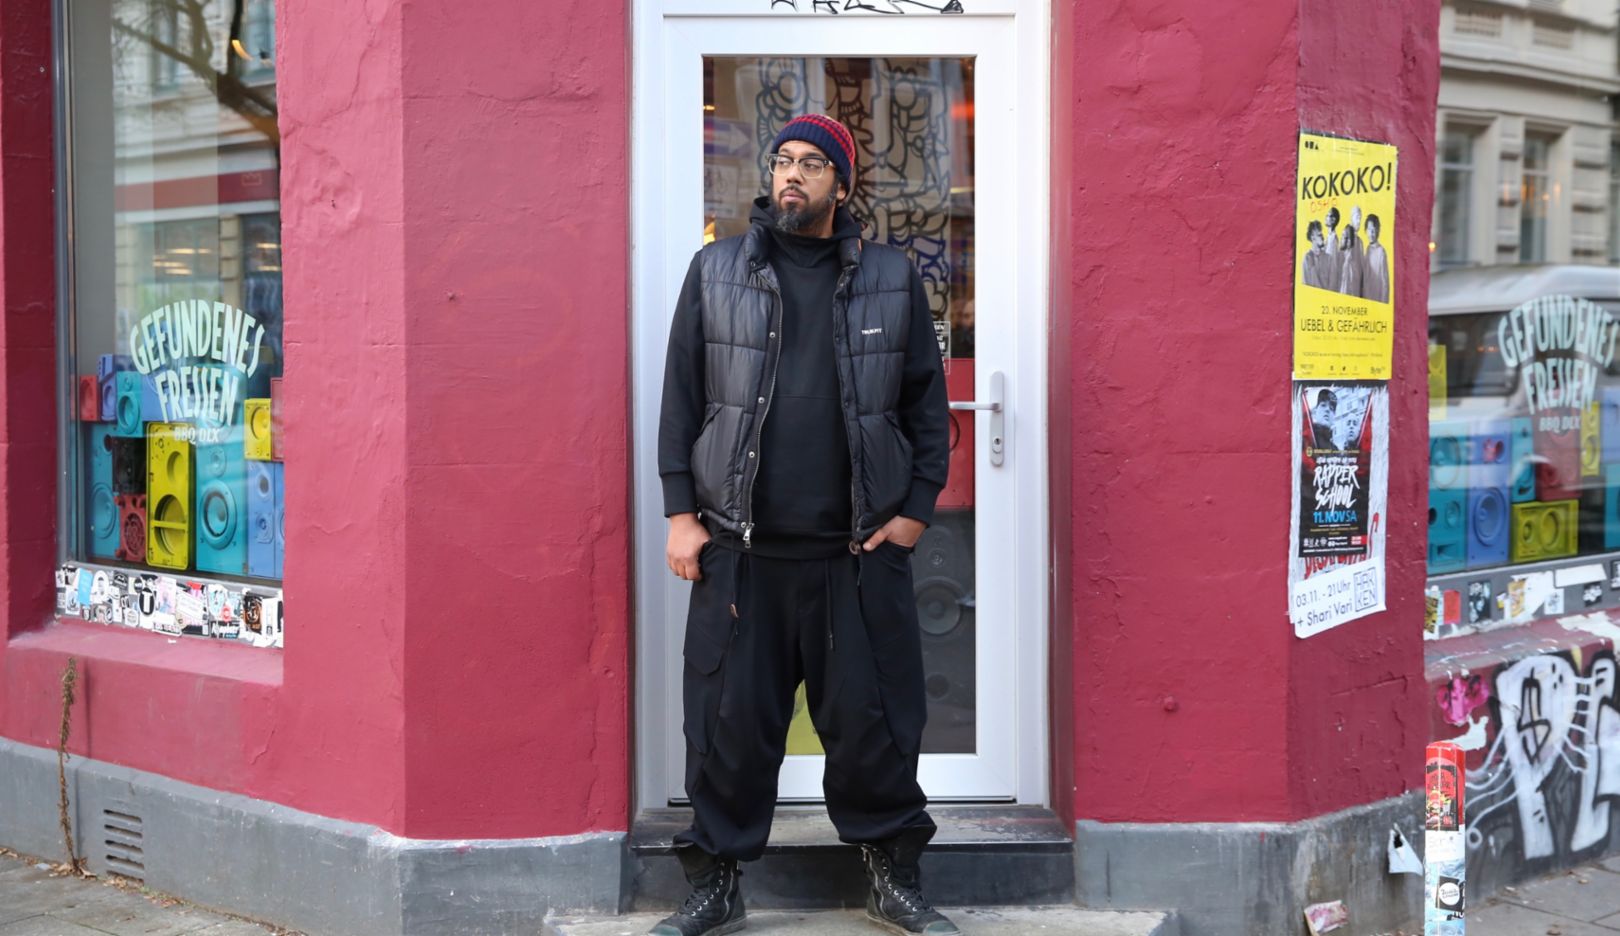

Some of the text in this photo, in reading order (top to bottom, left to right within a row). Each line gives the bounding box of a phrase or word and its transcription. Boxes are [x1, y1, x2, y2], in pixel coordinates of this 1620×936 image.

[1302, 162, 1392, 200] KOKOKO!
[1300, 318, 1326, 332] UEBEL
[1327, 319, 1334, 332] &
[1332, 306, 1368, 316] NOVEMBER
[129, 298, 266, 379] GEFUNDENES
[1497, 293, 1619, 368] GEFUNDENES
[154, 366, 239, 427] FRESSEN
[1522, 357, 1598, 415] FRESSEN
[173, 426, 197, 444] BBQ
[1313, 464, 1360, 490] RAPPER
[1315, 484, 1357, 512] SCHOOL
[1307, 605, 1332, 627] Shari
